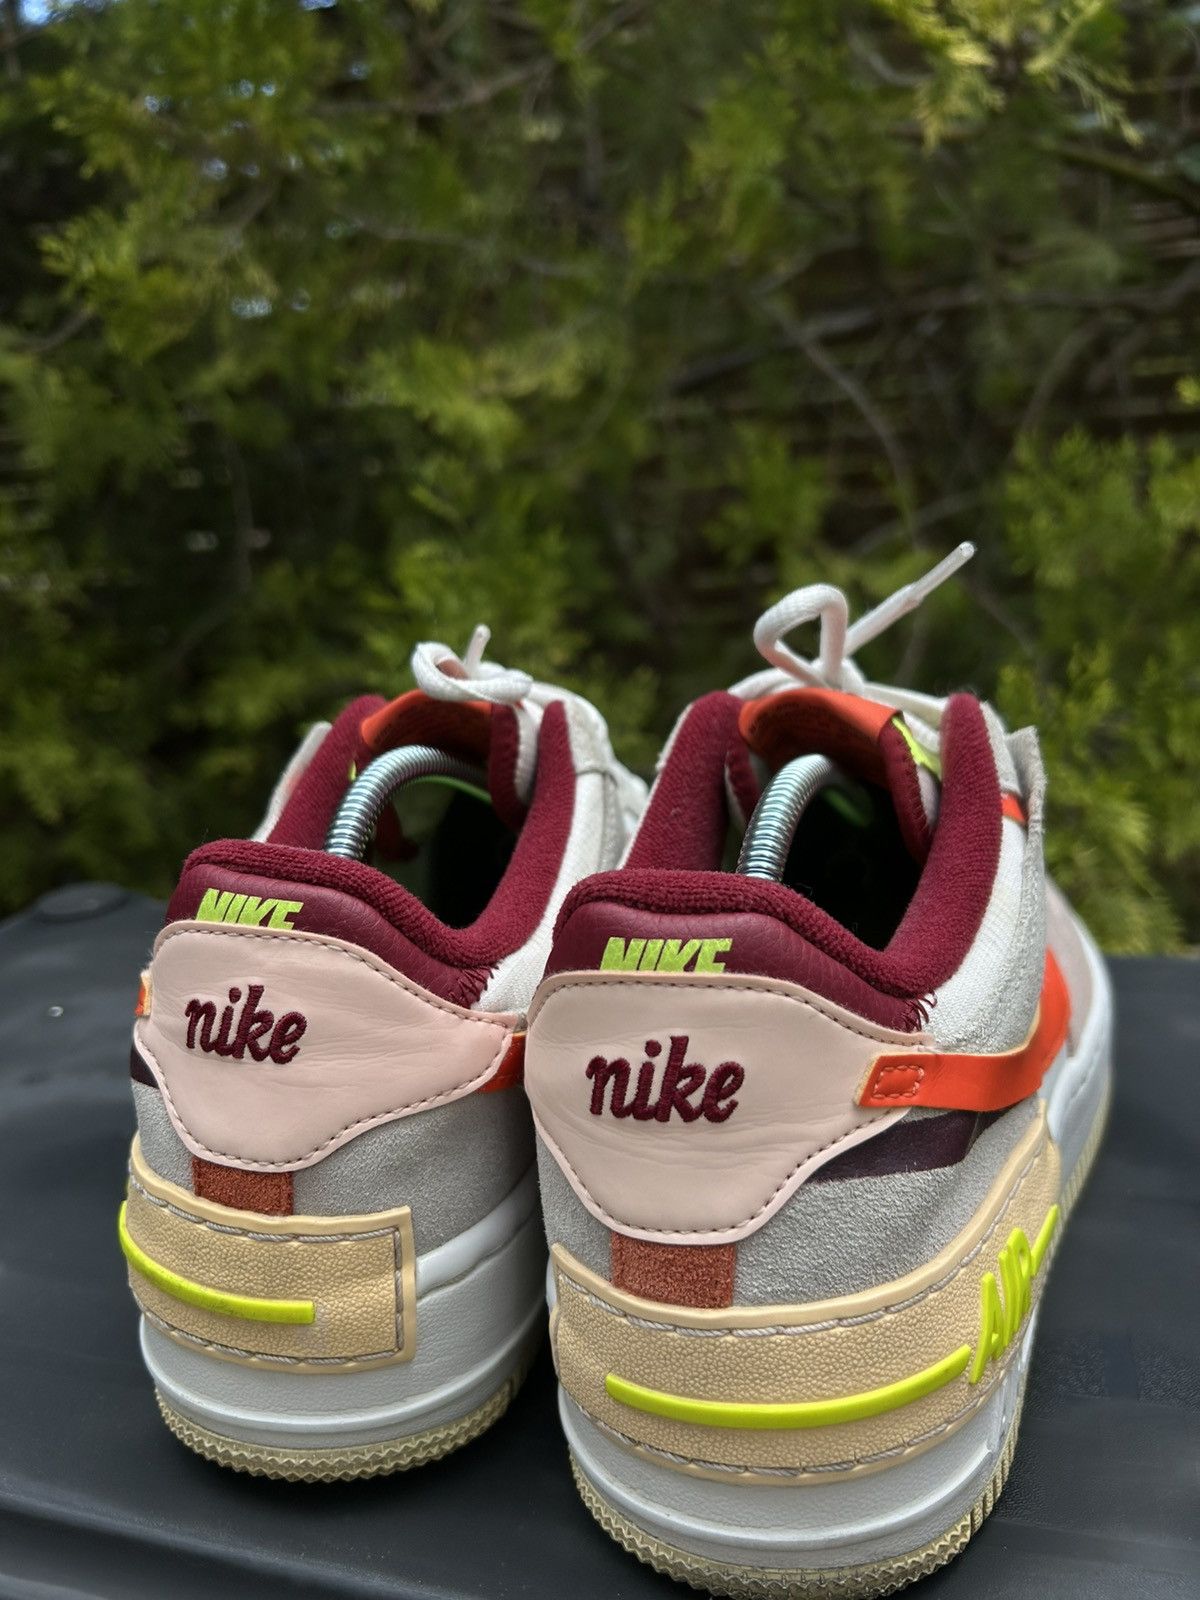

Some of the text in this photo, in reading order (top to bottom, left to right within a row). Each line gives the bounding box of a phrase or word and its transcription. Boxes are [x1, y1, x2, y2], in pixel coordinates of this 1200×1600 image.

[197, 888, 304, 930] NIKE
[600, 937, 733, 973] NIKE
[185, 984, 308, 1065] nike
[585, 1035, 746, 1124] nike
[969, 1227, 1032, 1385] AIR
